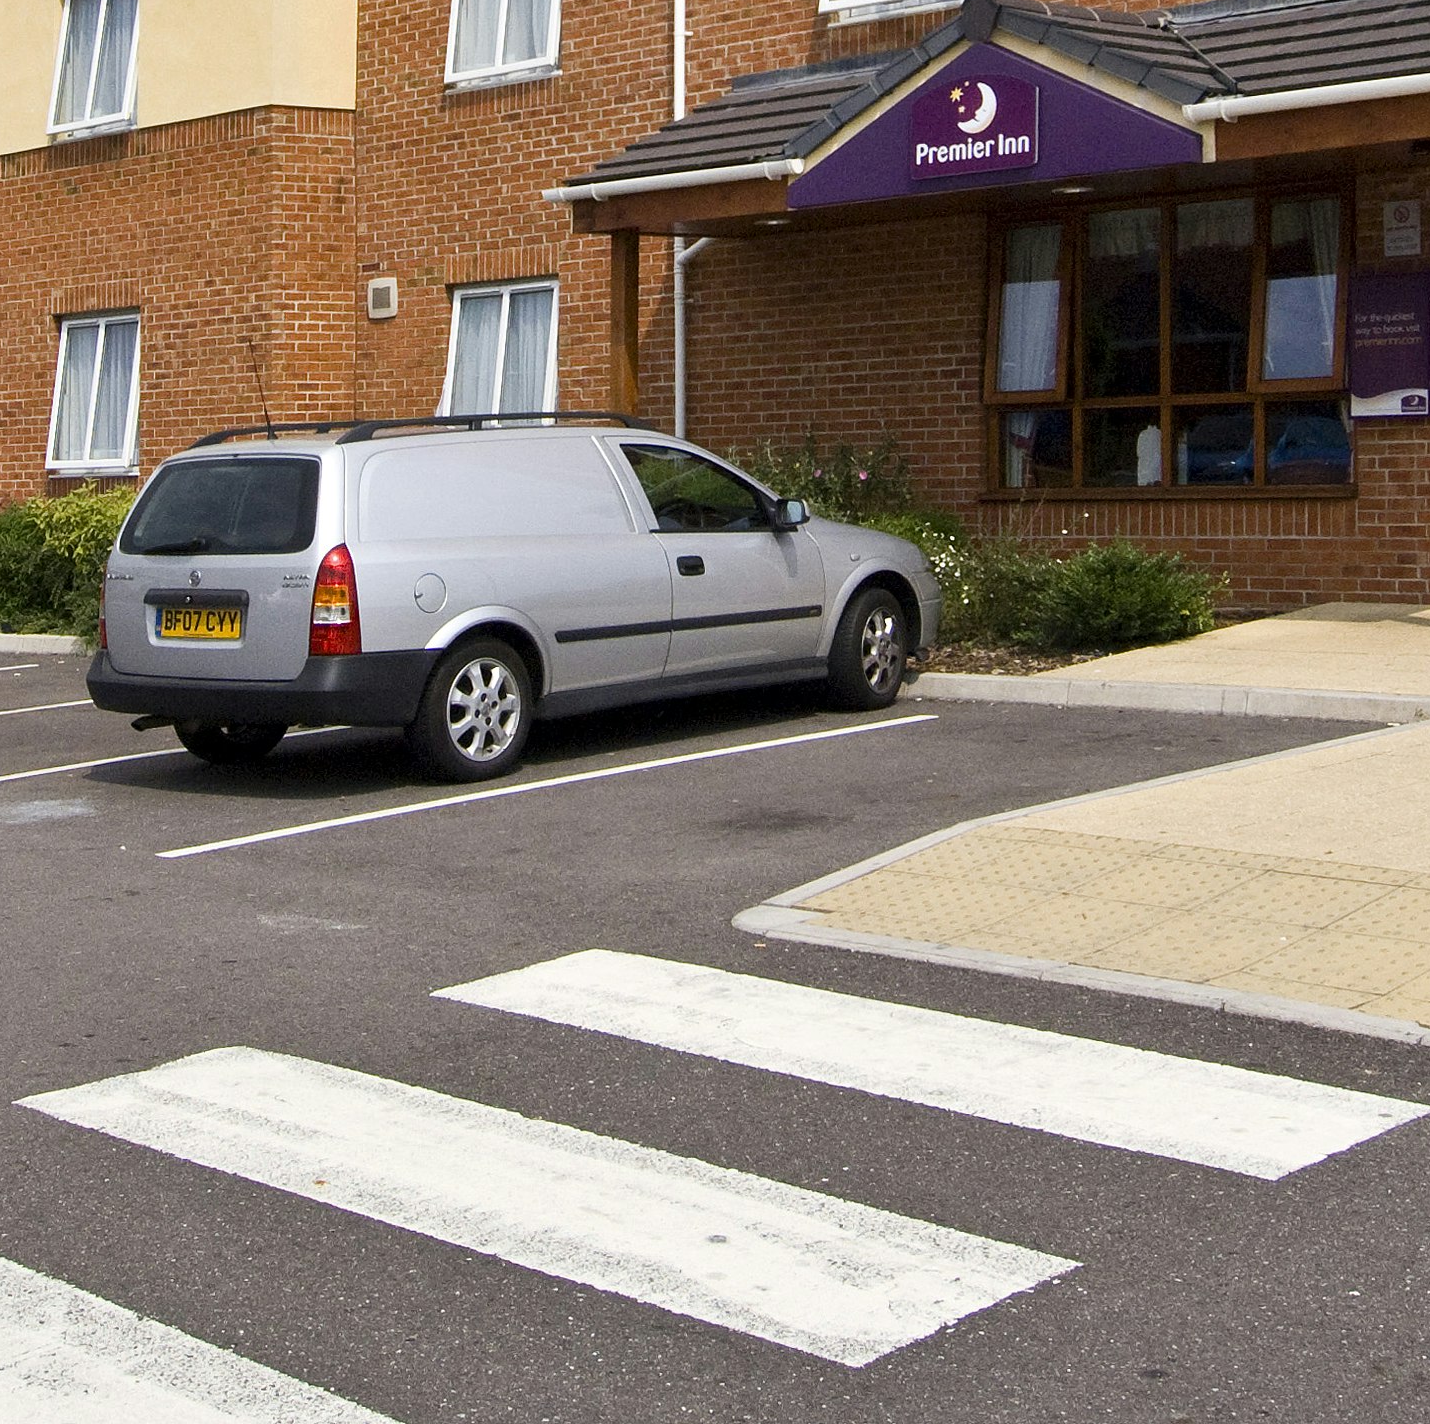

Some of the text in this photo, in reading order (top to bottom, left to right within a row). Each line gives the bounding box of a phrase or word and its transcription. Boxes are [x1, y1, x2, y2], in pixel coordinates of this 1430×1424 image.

[915, 133, 1030, 166] Premier Inn
[164, 610, 238, 633] BF07 CYY
